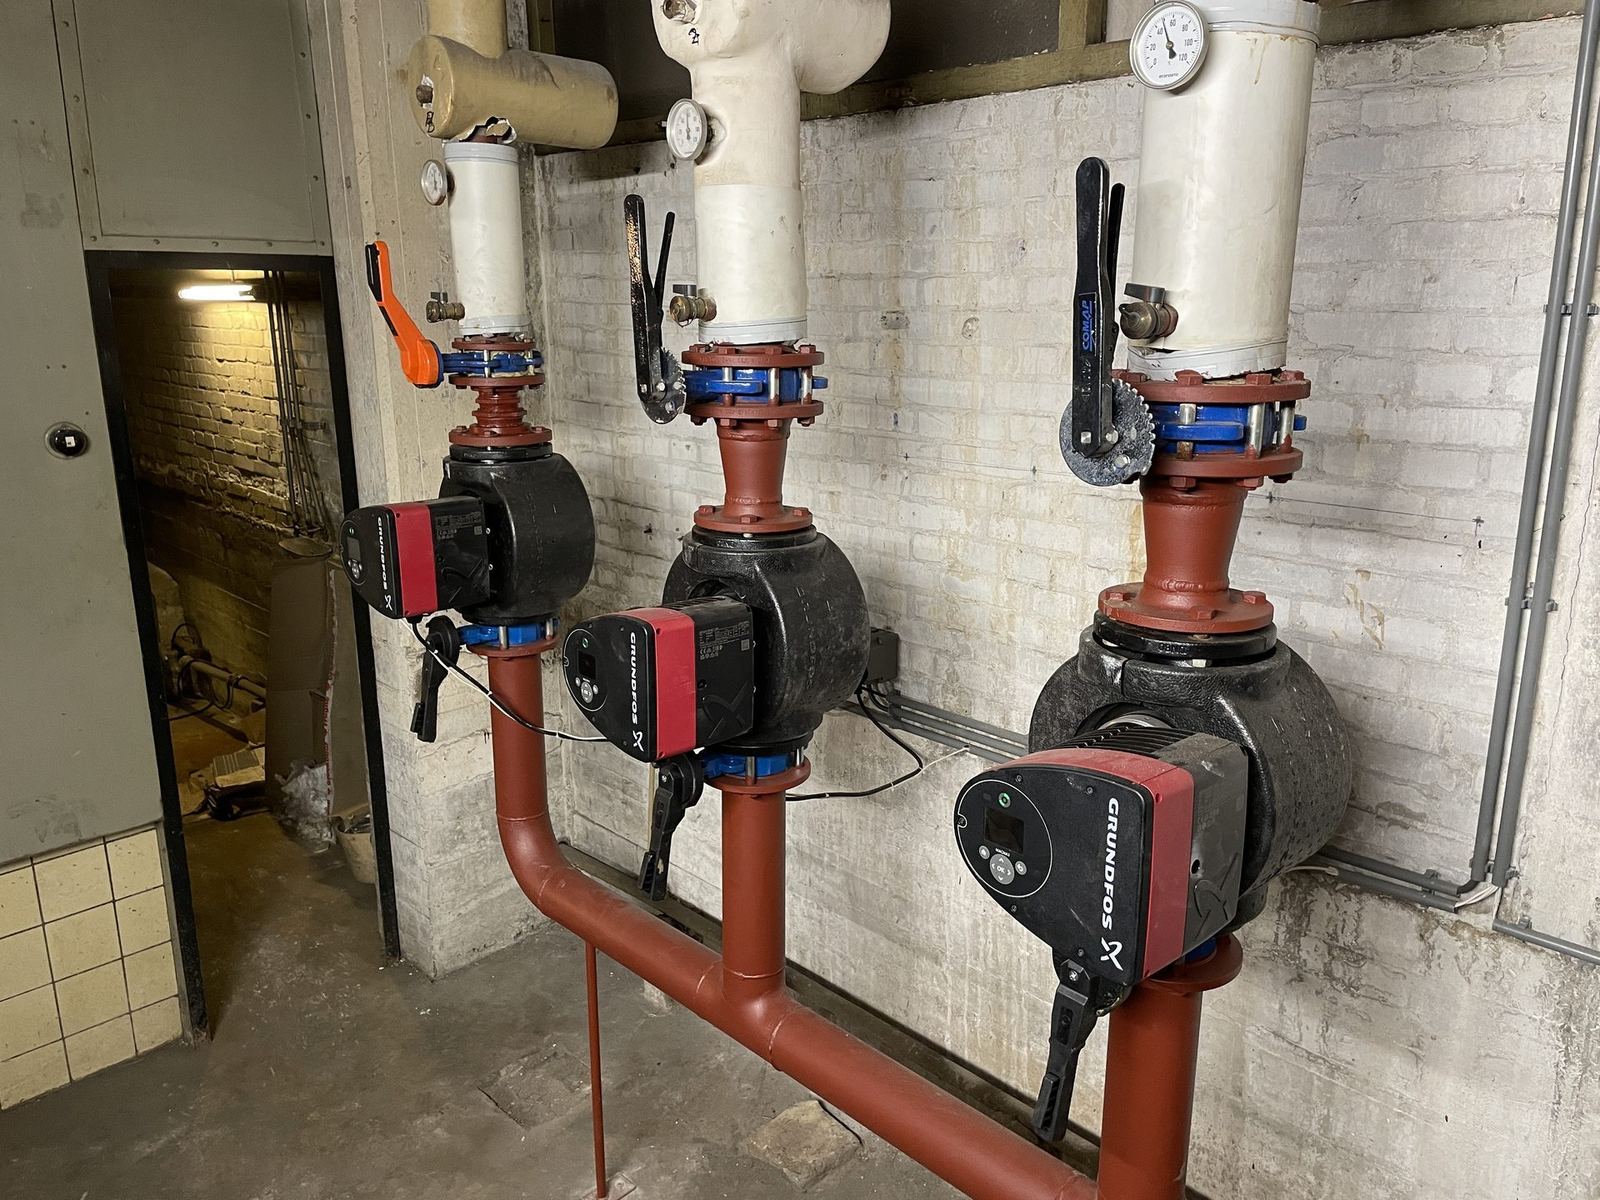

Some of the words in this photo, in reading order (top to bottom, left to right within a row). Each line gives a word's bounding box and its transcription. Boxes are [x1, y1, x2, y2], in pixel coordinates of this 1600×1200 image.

[1149, 43, 1157, 51] 20
[1178, 53, 1188, 61] 120
[1184, 38, 1194, 47] 100
[1082, 300, 1090, 350] COMAP
[377, 516, 388, 590] GRUNDFOS
[630, 631, 638, 725] GRUNDFOS
[1101, 797, 1119, 931] GRUNDFOS
